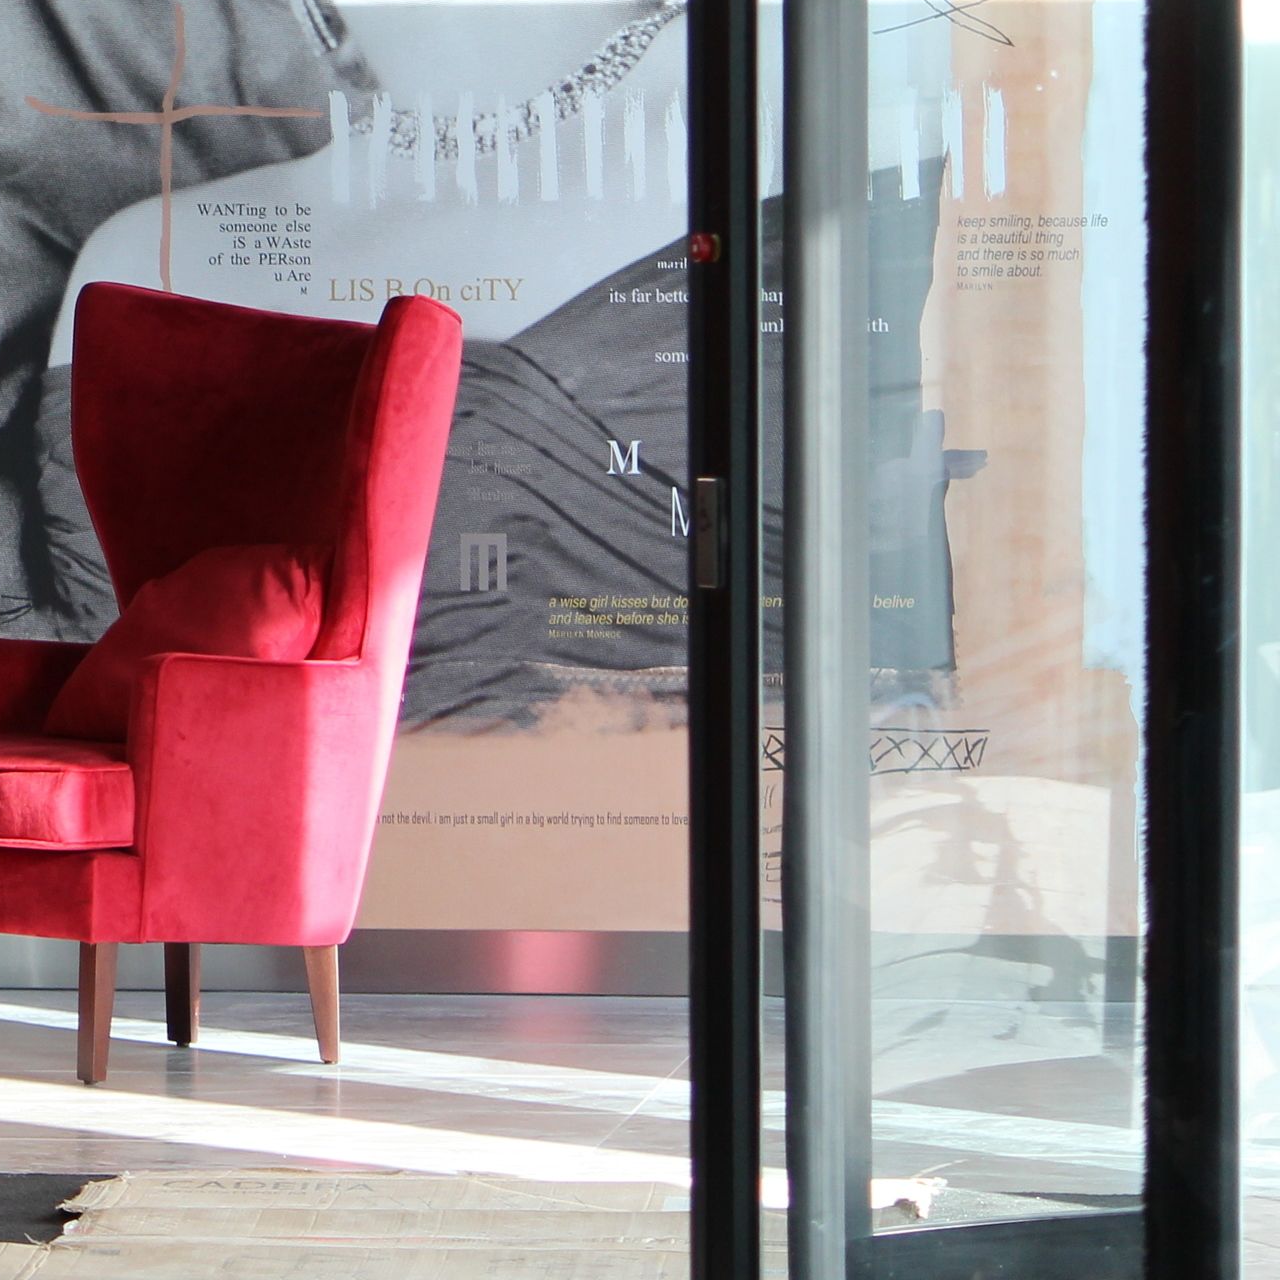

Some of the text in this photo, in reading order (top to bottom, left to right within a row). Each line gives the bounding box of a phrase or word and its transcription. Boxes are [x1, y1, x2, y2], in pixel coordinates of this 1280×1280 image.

[197, 203, 312, 219] WANTing to be
[219, 220, 312, 233] someone else
[956, 215, 986, 230] keep
[1037, 214, 1088, 228] because
[1090, 213, 1109, 228] life
[233, 236, 312, 249] iS a WAste
[956, 231, 1065, 247] is a beautiful thing
[208, 253, 312, 266] of the PERson
[956, 247, 1080, 261] and there is so much
[274, 269, 312, 282] u Are
[956, 266, 969, 277] to
[971, 264, 1004, 277] smile
[328, 278, 376, 302] LIS
[459, 278, 525, 302] ciTY
[609, 287, 652, 303] its far
[606, 439, 643, 475] M
[548, 595, 671, 612] a wise girl kisses but
[548, 611, 679, 625] and leaves before she
[381, 813, 396, 825] not
[397, 812, 410, 825] the
[439, 815, 452, 825] am
[453, 813, 468, 827] just
[477, 812, 499, 825] small
[500, 812, 514, 827] girl
[516, 813, 524, 825] in
[532, 812, 545, 828] big
[570, 813, 595, 828] trying
[596, 813, 605, 825] to
[607, 812, 622, 825] find
[624, 815, 660, 826] someone
[661, 813, 670, 825] to
